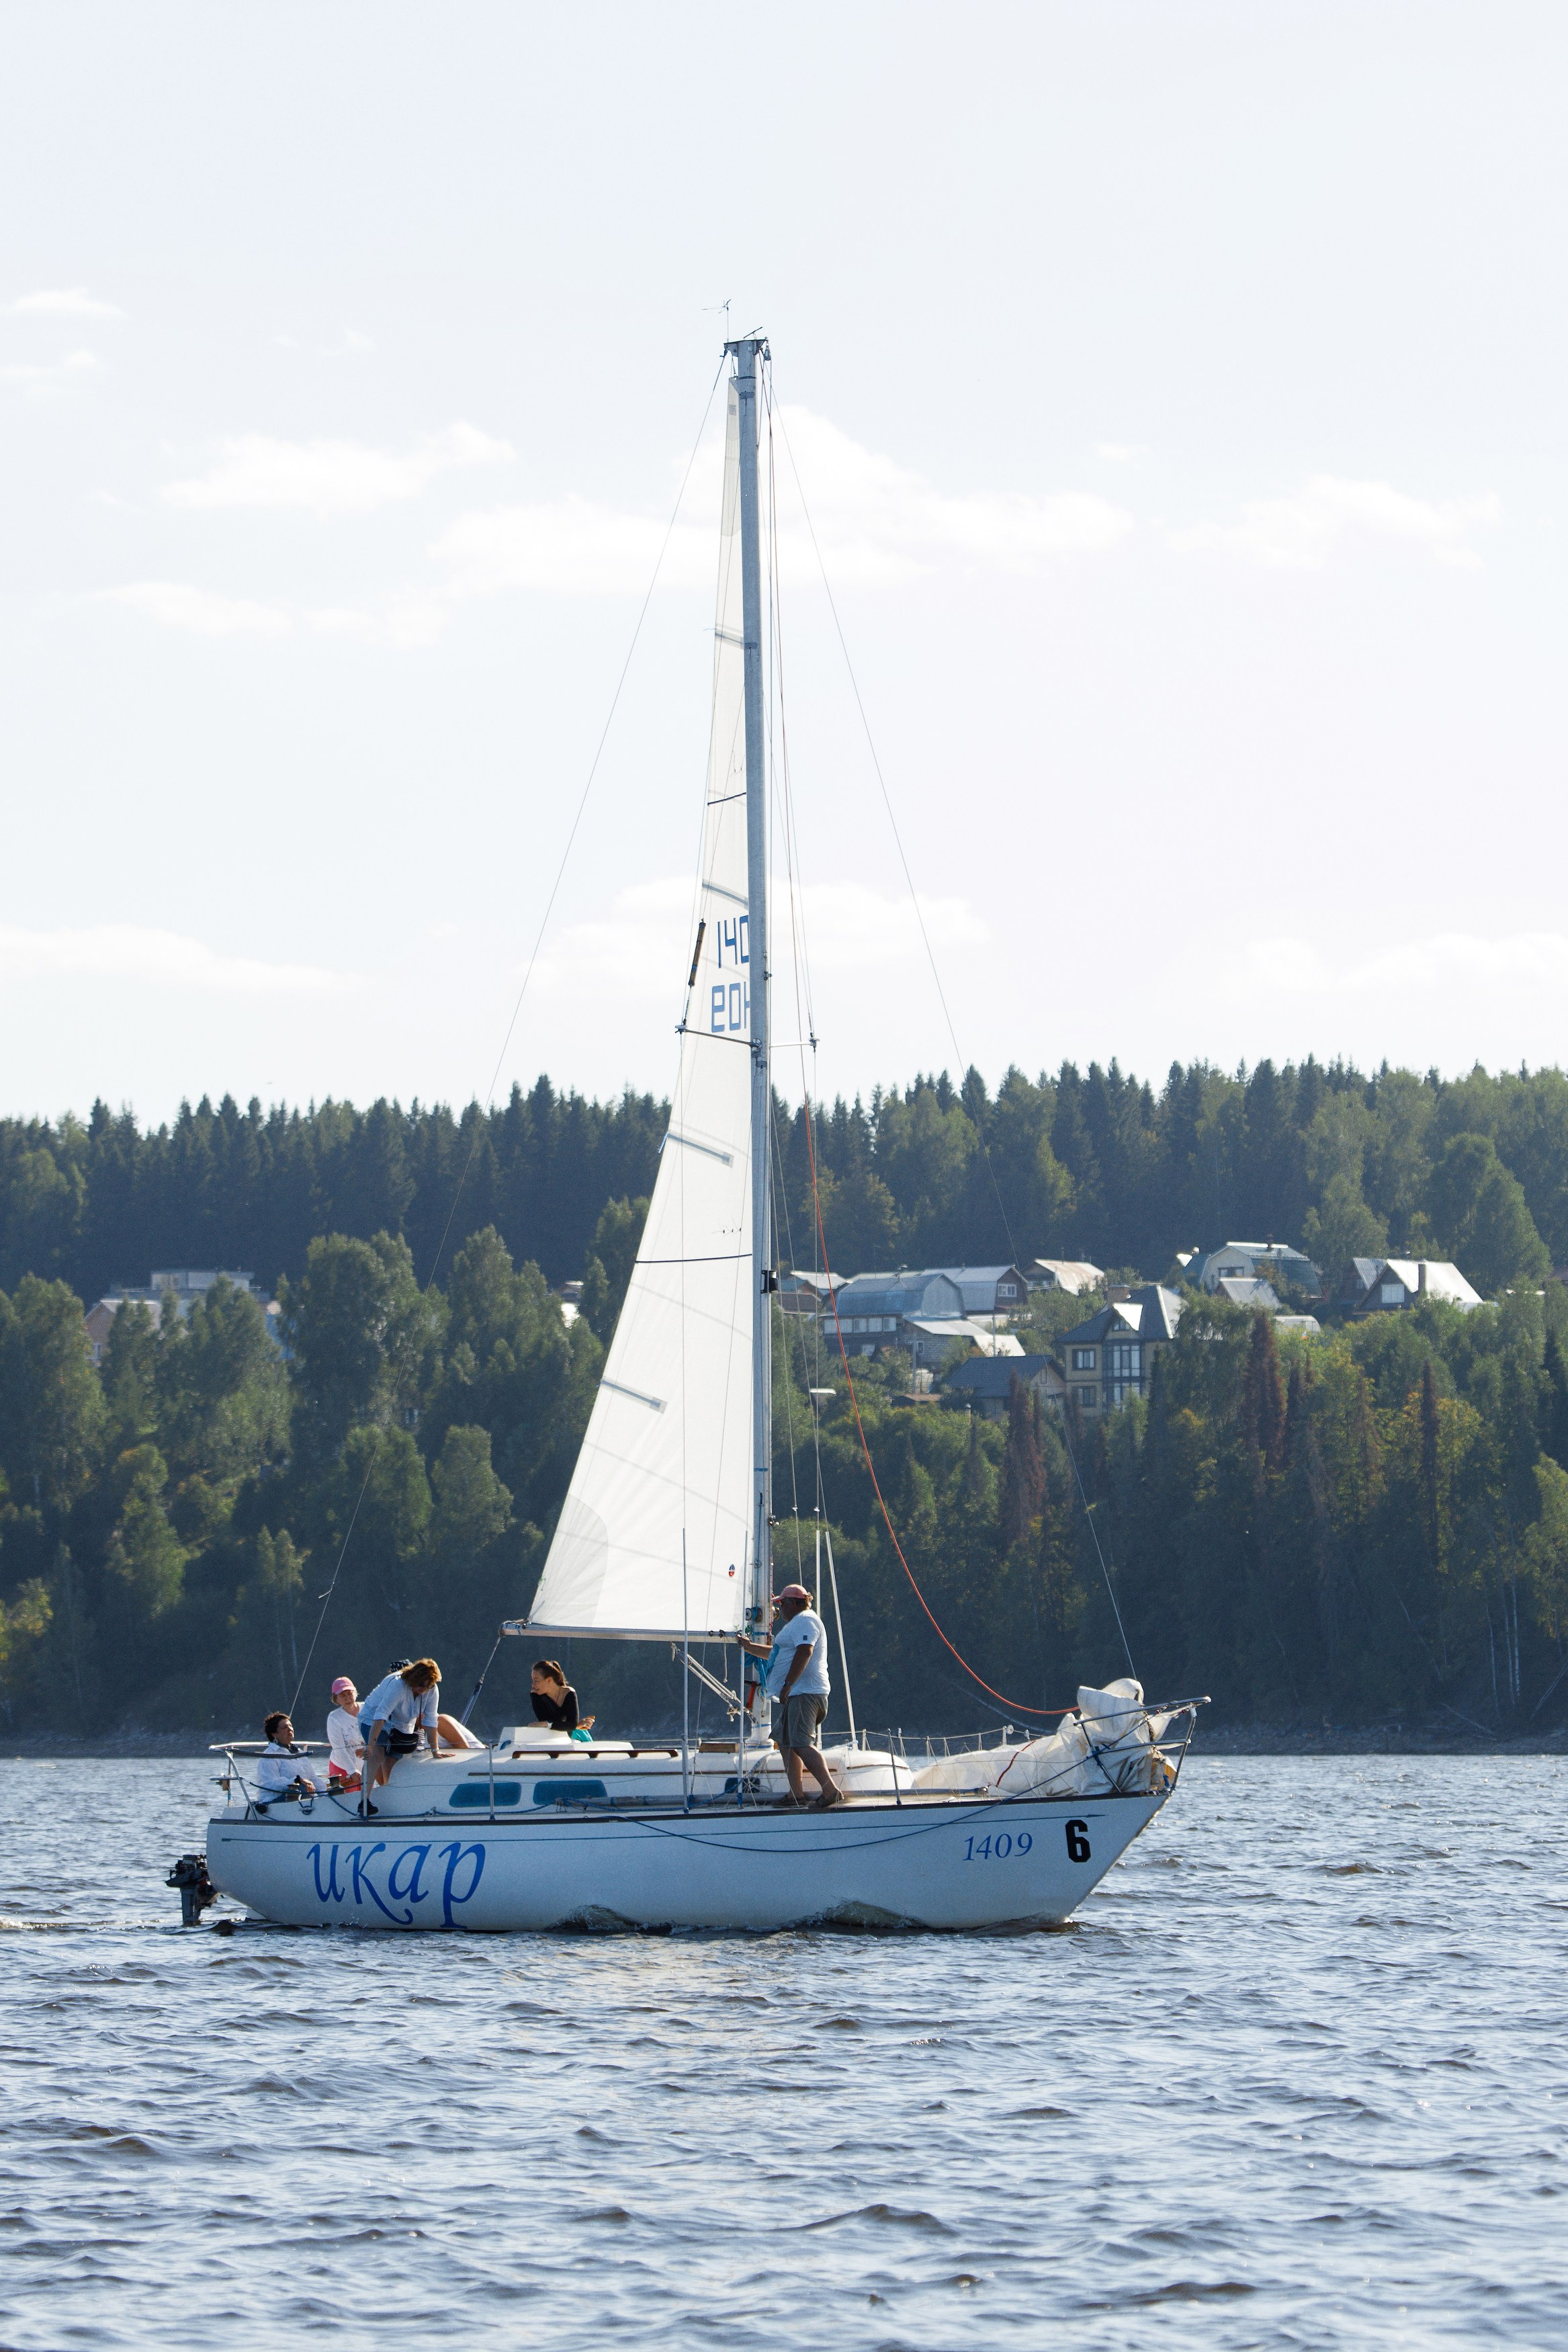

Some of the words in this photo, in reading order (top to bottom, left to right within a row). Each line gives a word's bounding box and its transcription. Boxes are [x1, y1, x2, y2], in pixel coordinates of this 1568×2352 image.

[963, 1833, 1033, 1861] 1409
[1065, 1820, 1091, 1863] 6
[306, 1843, 486, 1929] икар
